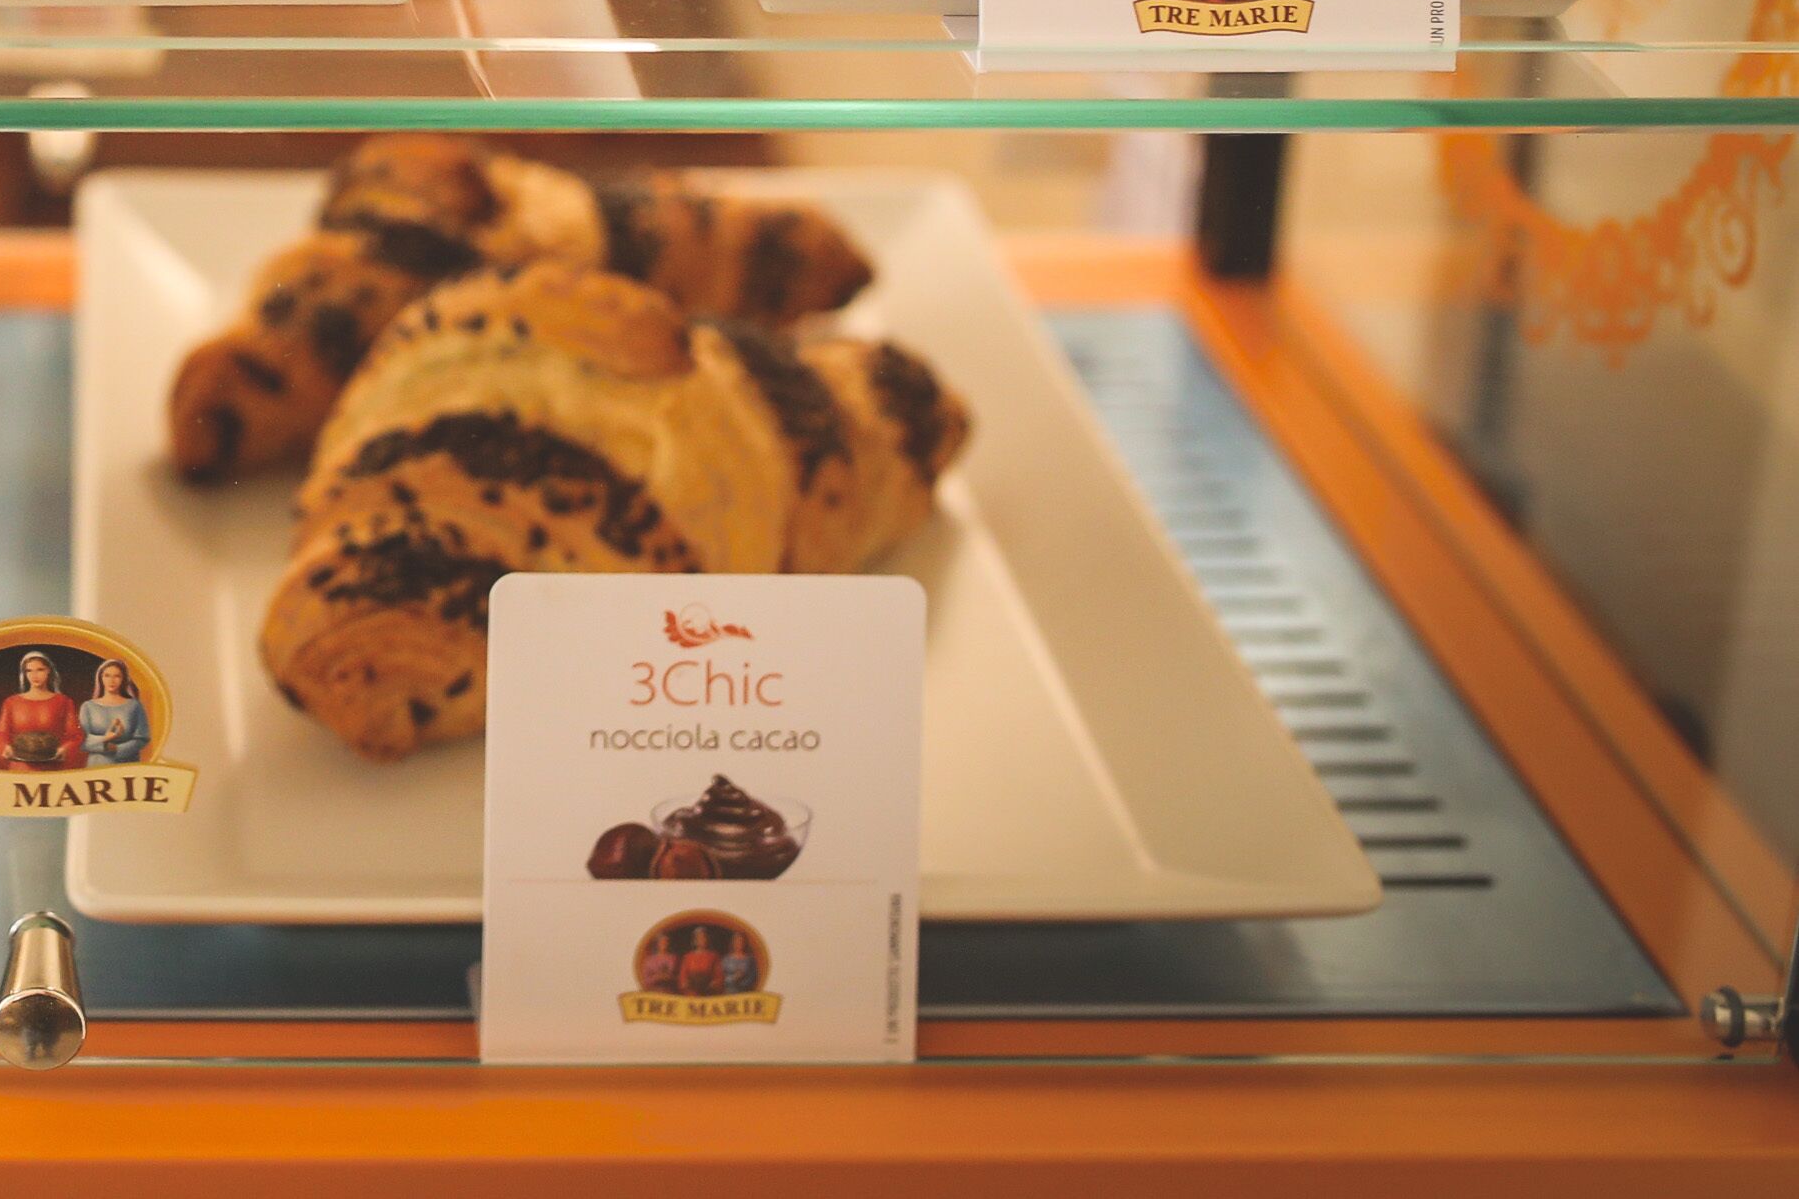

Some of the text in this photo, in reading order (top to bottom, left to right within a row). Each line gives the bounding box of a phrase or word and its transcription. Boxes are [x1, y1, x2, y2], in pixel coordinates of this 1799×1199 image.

[1148, 2, 1299, 29] TRE MARIE
[628, 659, 784, 708] 3Chic
[589, 722, 822, 753] nocciola cacao
[12, 775, 171, 809] MARIE
[635, 997, 768, 1020] TRE MARIE
